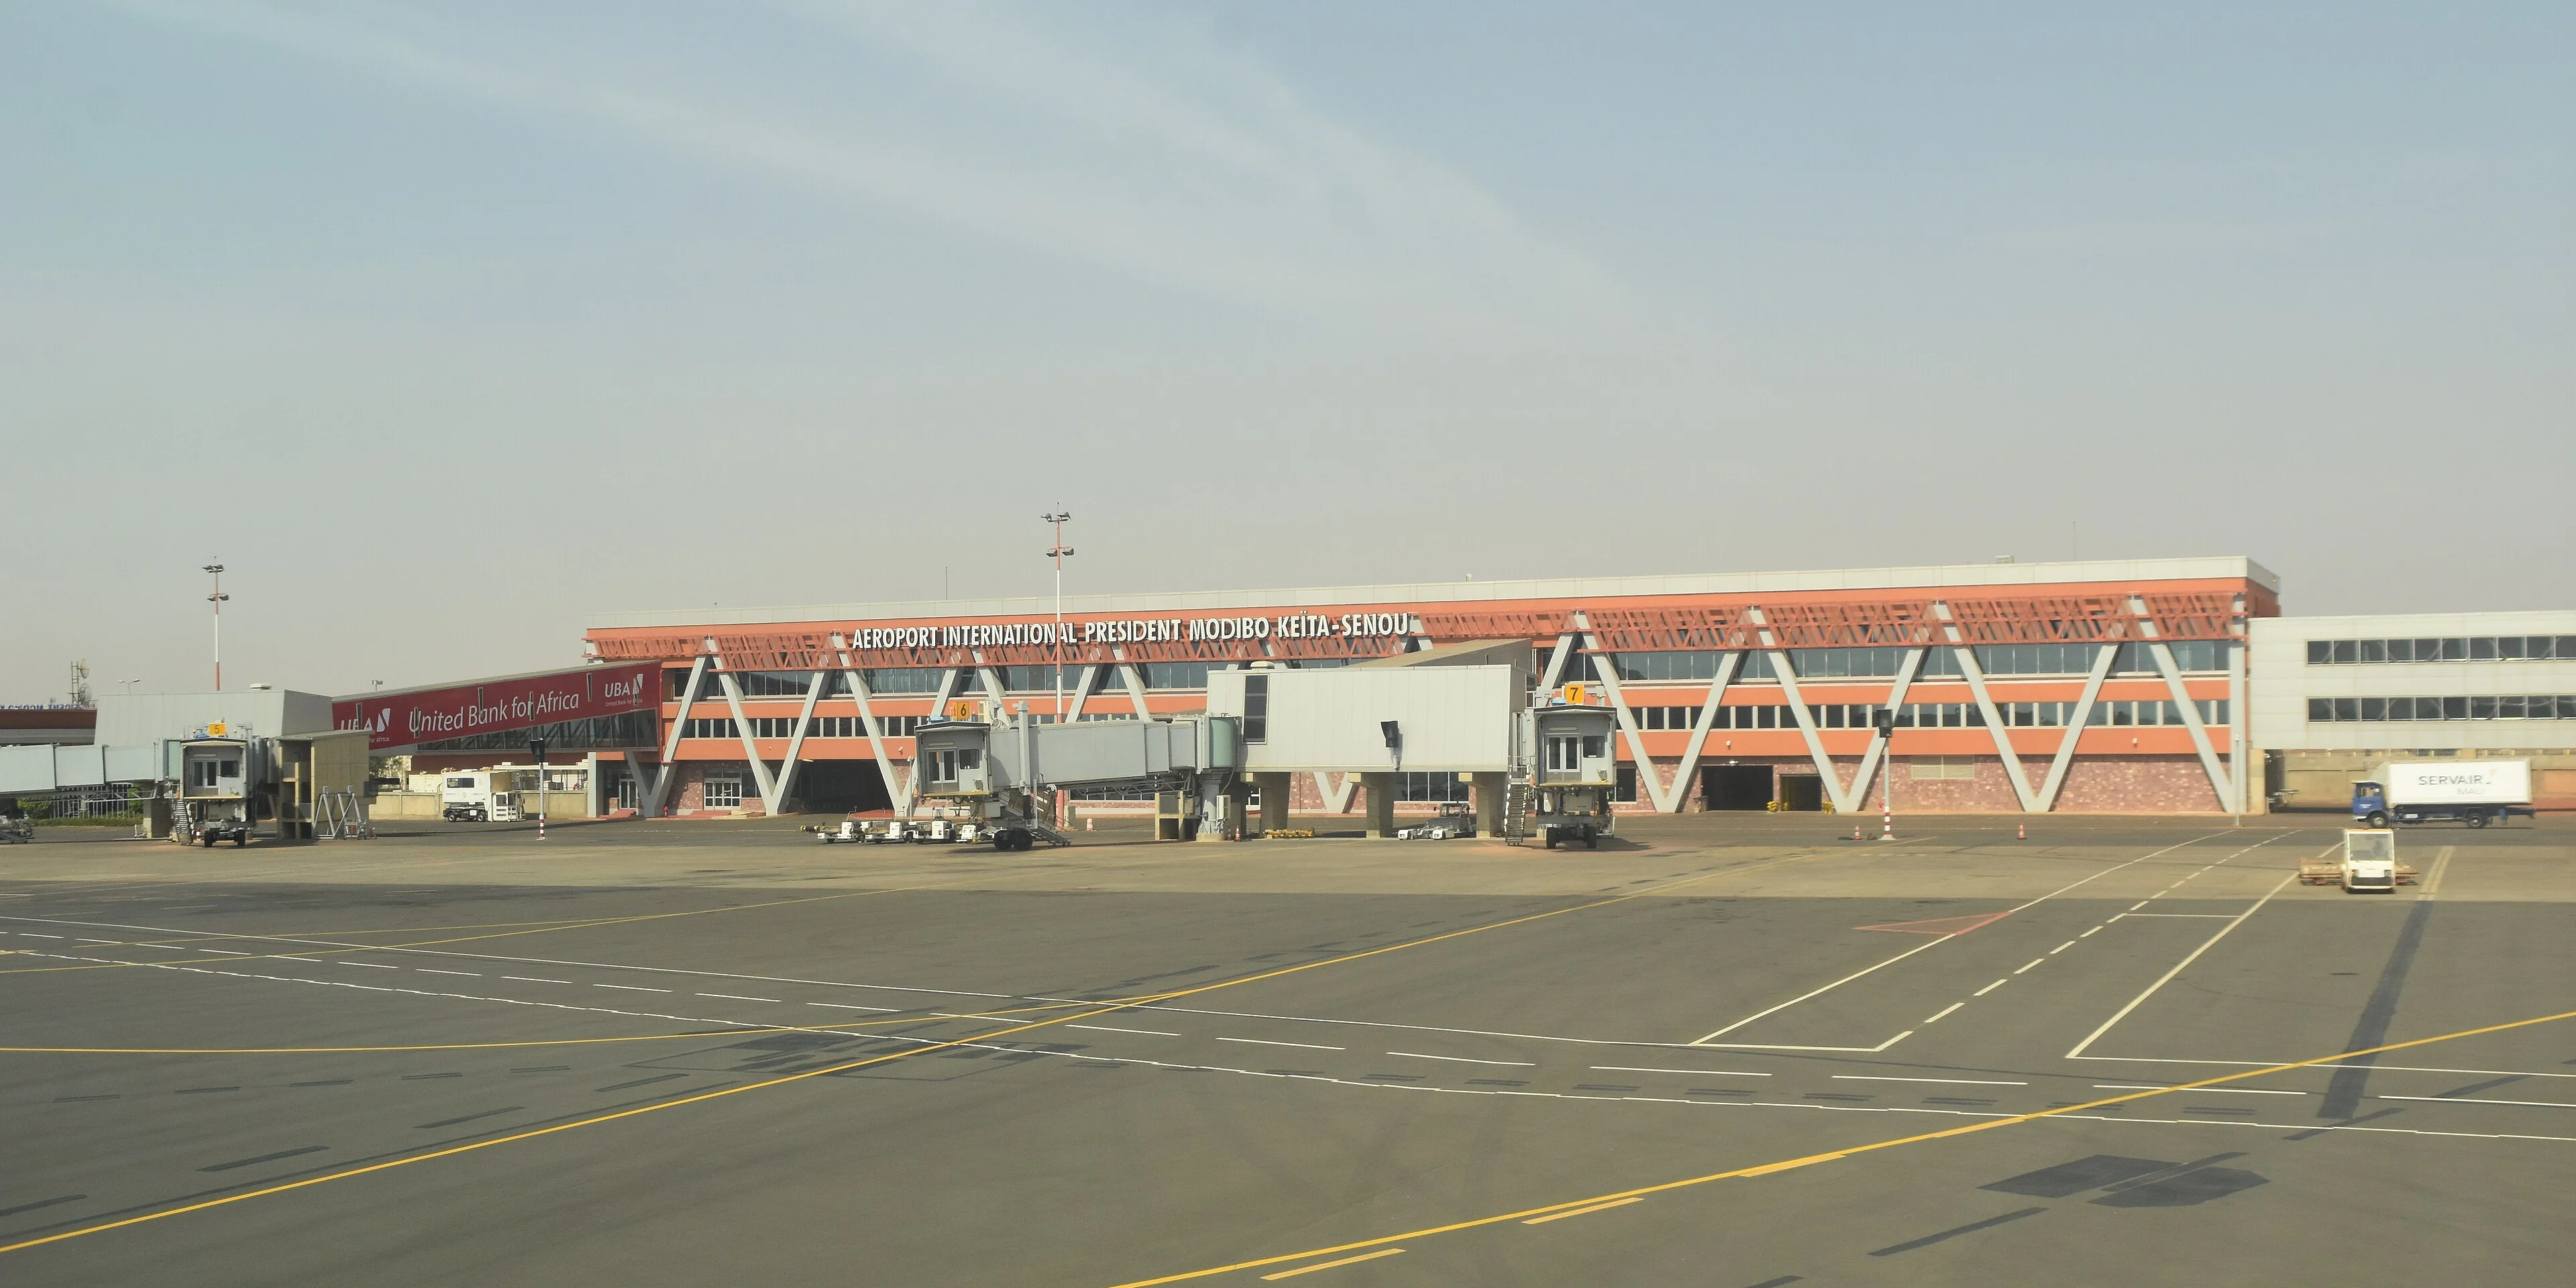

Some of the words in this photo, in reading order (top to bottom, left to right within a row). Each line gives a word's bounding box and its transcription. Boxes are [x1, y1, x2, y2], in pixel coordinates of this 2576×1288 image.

[853, 626, 938, 649] AEROPORT
[943, 623, 1077, 646] INTERNATIONAL
[1085, 619, 1181, 643] PRESIDENT
[1189, 616, 1269, 641] MODIBO
[605, 682, 630, 698] UBA
[1570, 687, 1578, 701] 7
[408, 706, 464, 733] United
[468, 699, 508, 727] Bank
[511, 696, 534, 718] for
[536, 690, 580, 714] Africa
[961, 703, 967, 716] 6
[215, 724, 220, 734] 5
[2418, 775, 2483, 786] SERVAIR
